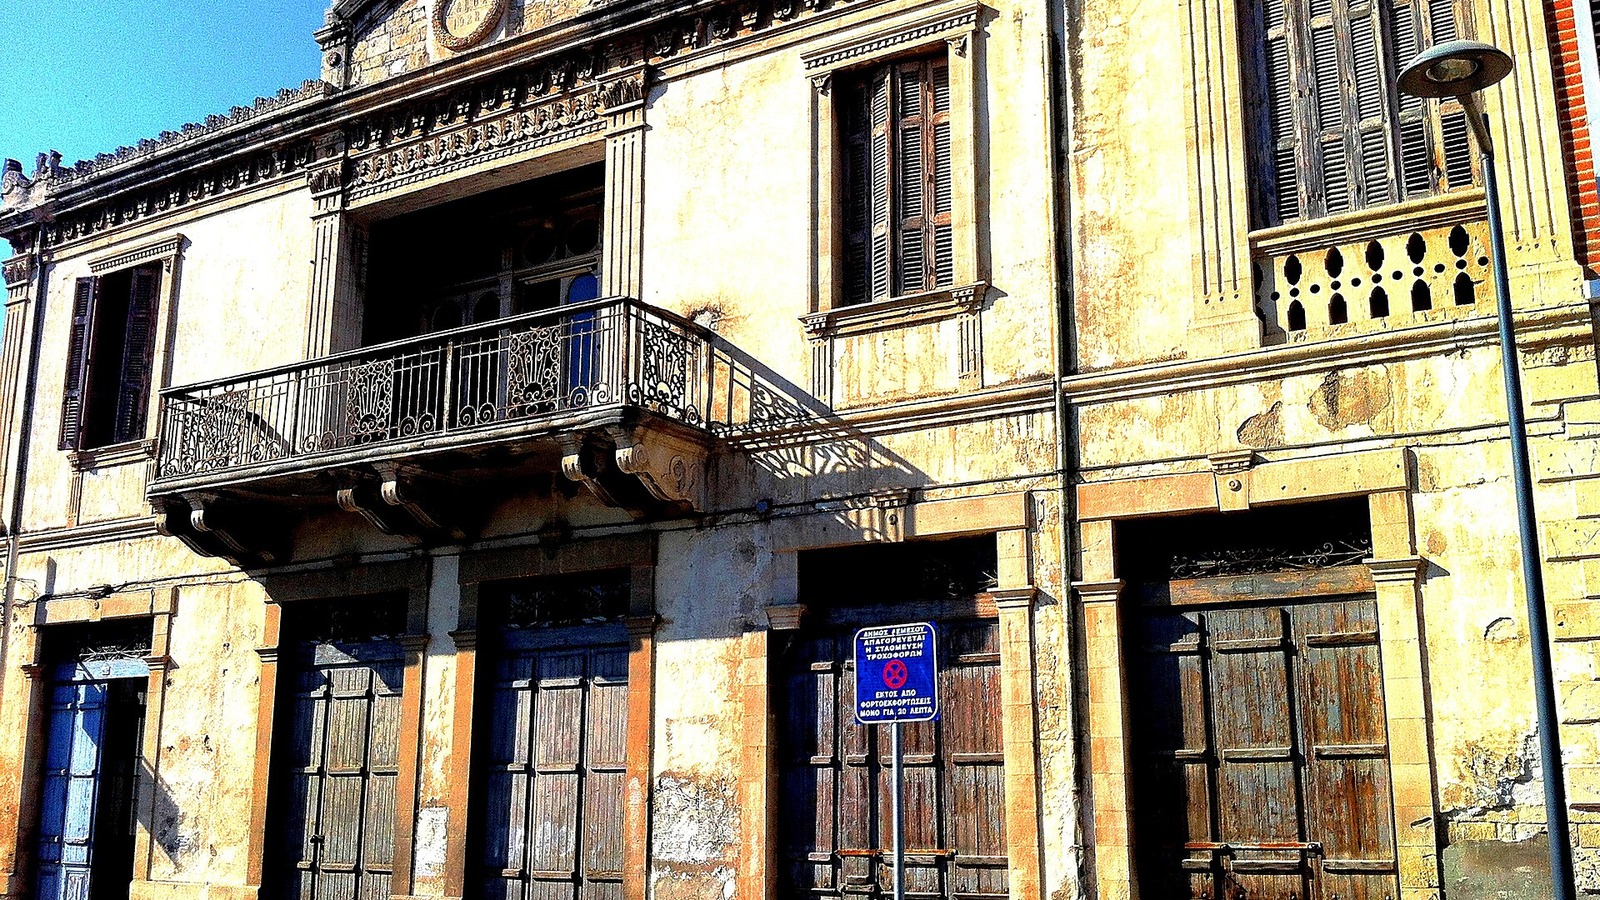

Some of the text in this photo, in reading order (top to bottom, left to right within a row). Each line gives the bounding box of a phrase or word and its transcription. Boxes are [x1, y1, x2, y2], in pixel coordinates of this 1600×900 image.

[863, 635, 925, 646] ΑΠΑΓΟΡΕΥΕΤΑΙ
[875, 642, 923, 652] ΣΤΑΘΜΕΥΣΗ
[866, 650, 923, 660] ΤΡΟΧΟΦΟΡΩΝ
[875, 689, 917, 699] ΕΚΤΟΣ ΑΠΟ
[860, 697, 932, 708] ΦΟΡΤΟΕΚΦΟΡΤΩΣΕΙΣ
[860, 706, 933, 717] ΜΟΝΟ ΓΙΑ 20 ΛΕΠΤΑ
